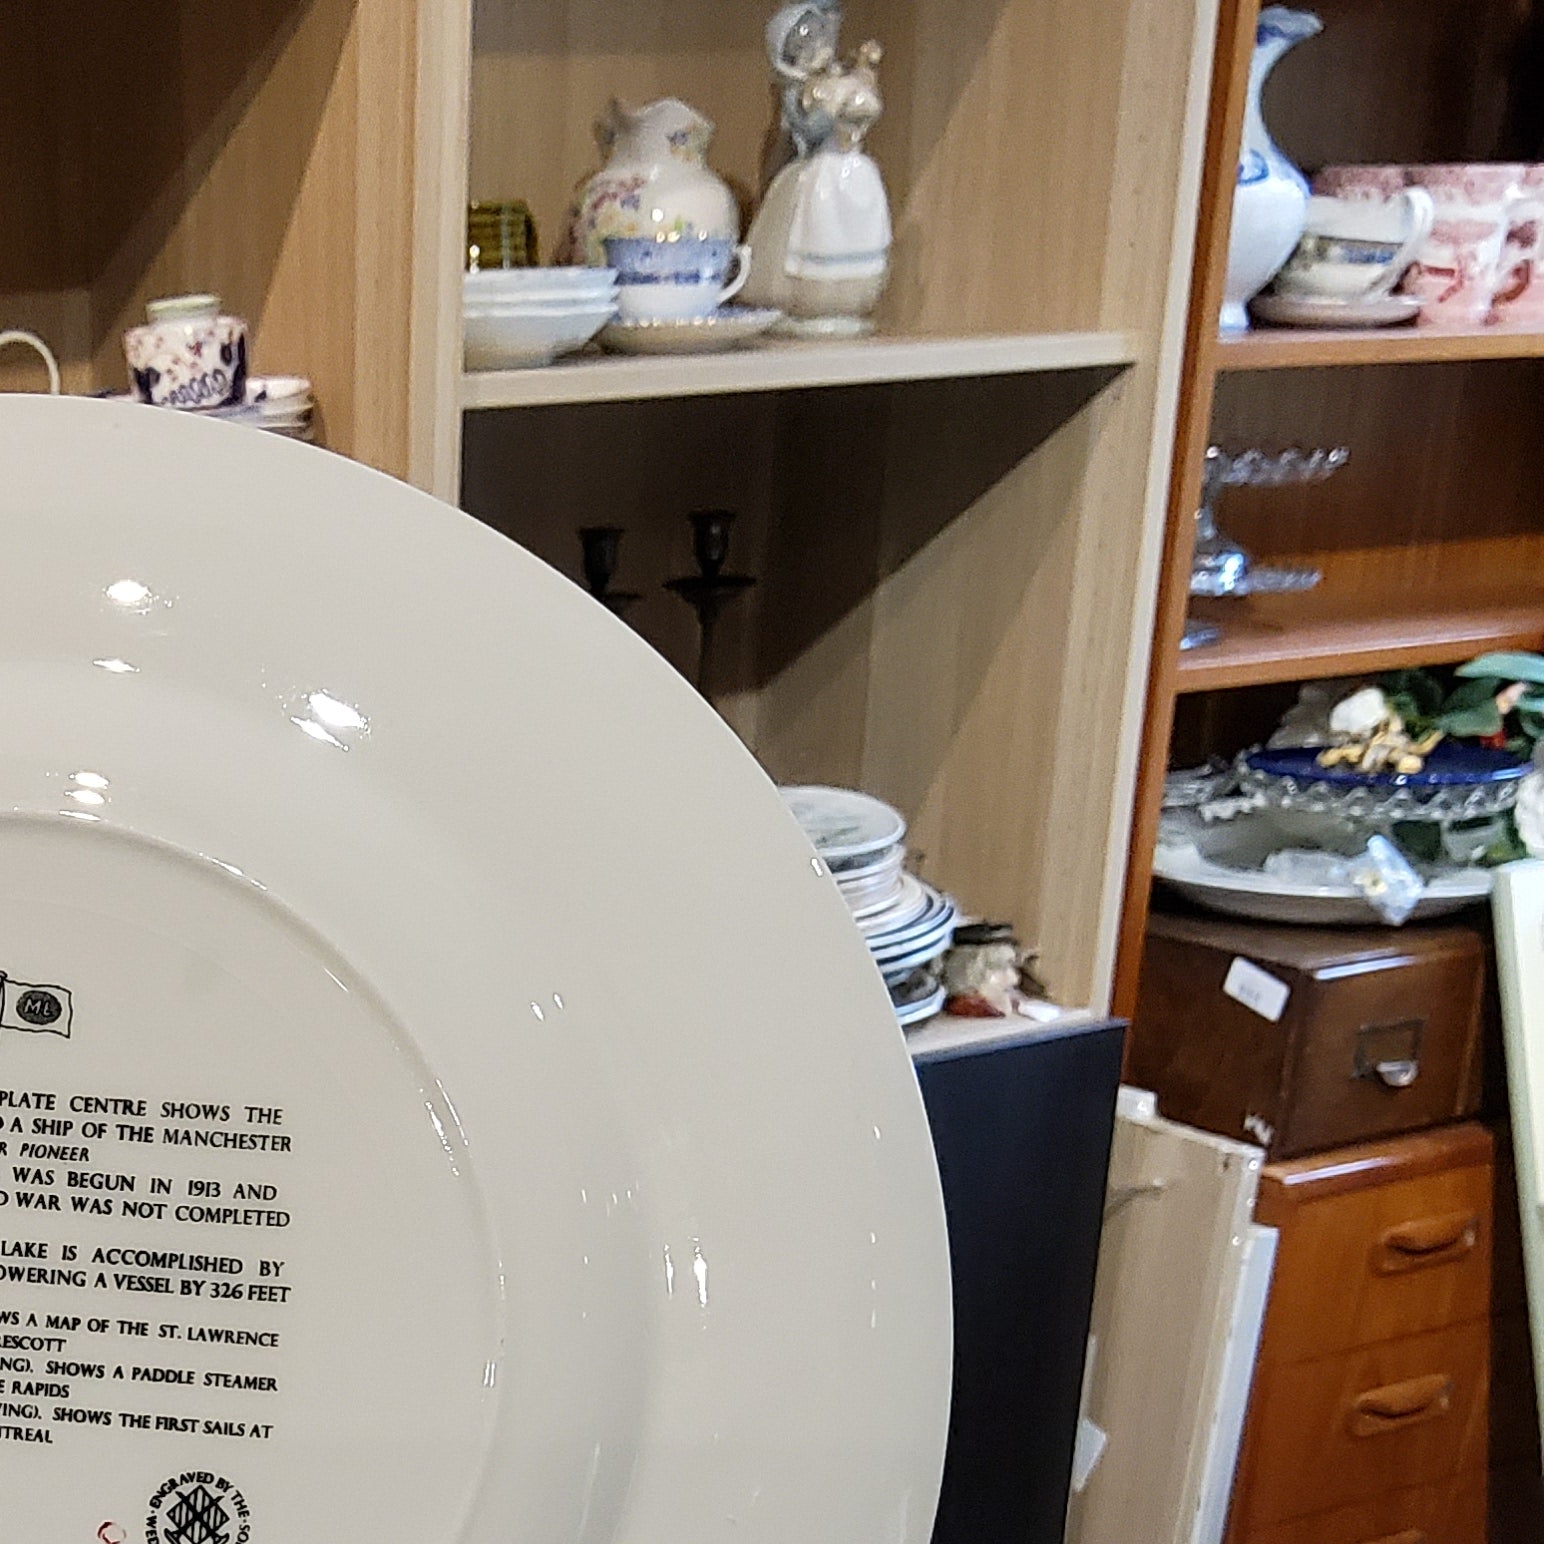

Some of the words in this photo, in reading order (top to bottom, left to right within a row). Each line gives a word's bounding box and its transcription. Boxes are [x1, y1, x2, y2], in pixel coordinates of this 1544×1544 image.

[70, 1096, 147, 1116] CENTRE
[160, 1102, 230, 1121] SHOWS
[244, 1106, 283, 1125] THE
[10, 1117, 23, 1133] A
[32, 1118, 73, 1136] SHIP
[82, 1122, 108, 1139] OF
[116, 1124, 154, 1143] THE
[163, 1128, 291, 1152] MANCHESTER
[20, 1143, 89, 1161] PIONEER
[13, 1167, 54, 1185] WAS
[68, 1171, 136, 1192] BEGUN
[150, 1178, 172, 1194] IN
[188, 1180, 221, 1197] 1913
[233, 1183, 277, 1200] AND
[16, 1192, 61, 1211] WAR
[71, 1196, 113, 1215] WAS
[122, 1201, 168, 1219] NOT
[175, 1206, 290, 1227] COMPLETED
[1, 1241, 48, 1259] LAKE
[62, 1245, 77, 1261] IS
[92, 1248, 243, 1274] ACCOMPLISHED
[259, 1260, 285, 1277] BY
[94, 1273, 107, 1288] A
[113, 1274, 174, 1294] VESSEL
[180, 1280, 206, 1296] BY
[210, 1282, 243, 1299] 326
[248, 1285, 291, 1302] FEET
[26, 1313, 38, 1327] A
[46, 1315, 81, 1331] MAP
[87, 1319, 110, 1333] OF
[116, 1320, 149, 1336] THE
[158, 1324, 181, 1339] ST.
[187, 1327, 279, 1347] LAWRENCE
[11, 1381, 69, 1398] RAPIDS
[46, 1361, 105, 1379] SHOWS
[113, 1366, 124, 1379] A
[132, 1367, 195, 1384] PADDLE
[203, 1373, 278, 1391] STEAMER
[52, 1407, 112, 1426] SHOWS
[118, 1413, 151, 1429] THE
[155, 1416, 200, 1433] FIRST
[202, 1421, 245, 1436] SAILS
[249, 1424, 273, 1438] AT
[149, 1471, 214, 1510] ENGRAVED
[215, 1477, 234, 1492] BY
[231, 1490, 250, 1518] THE
